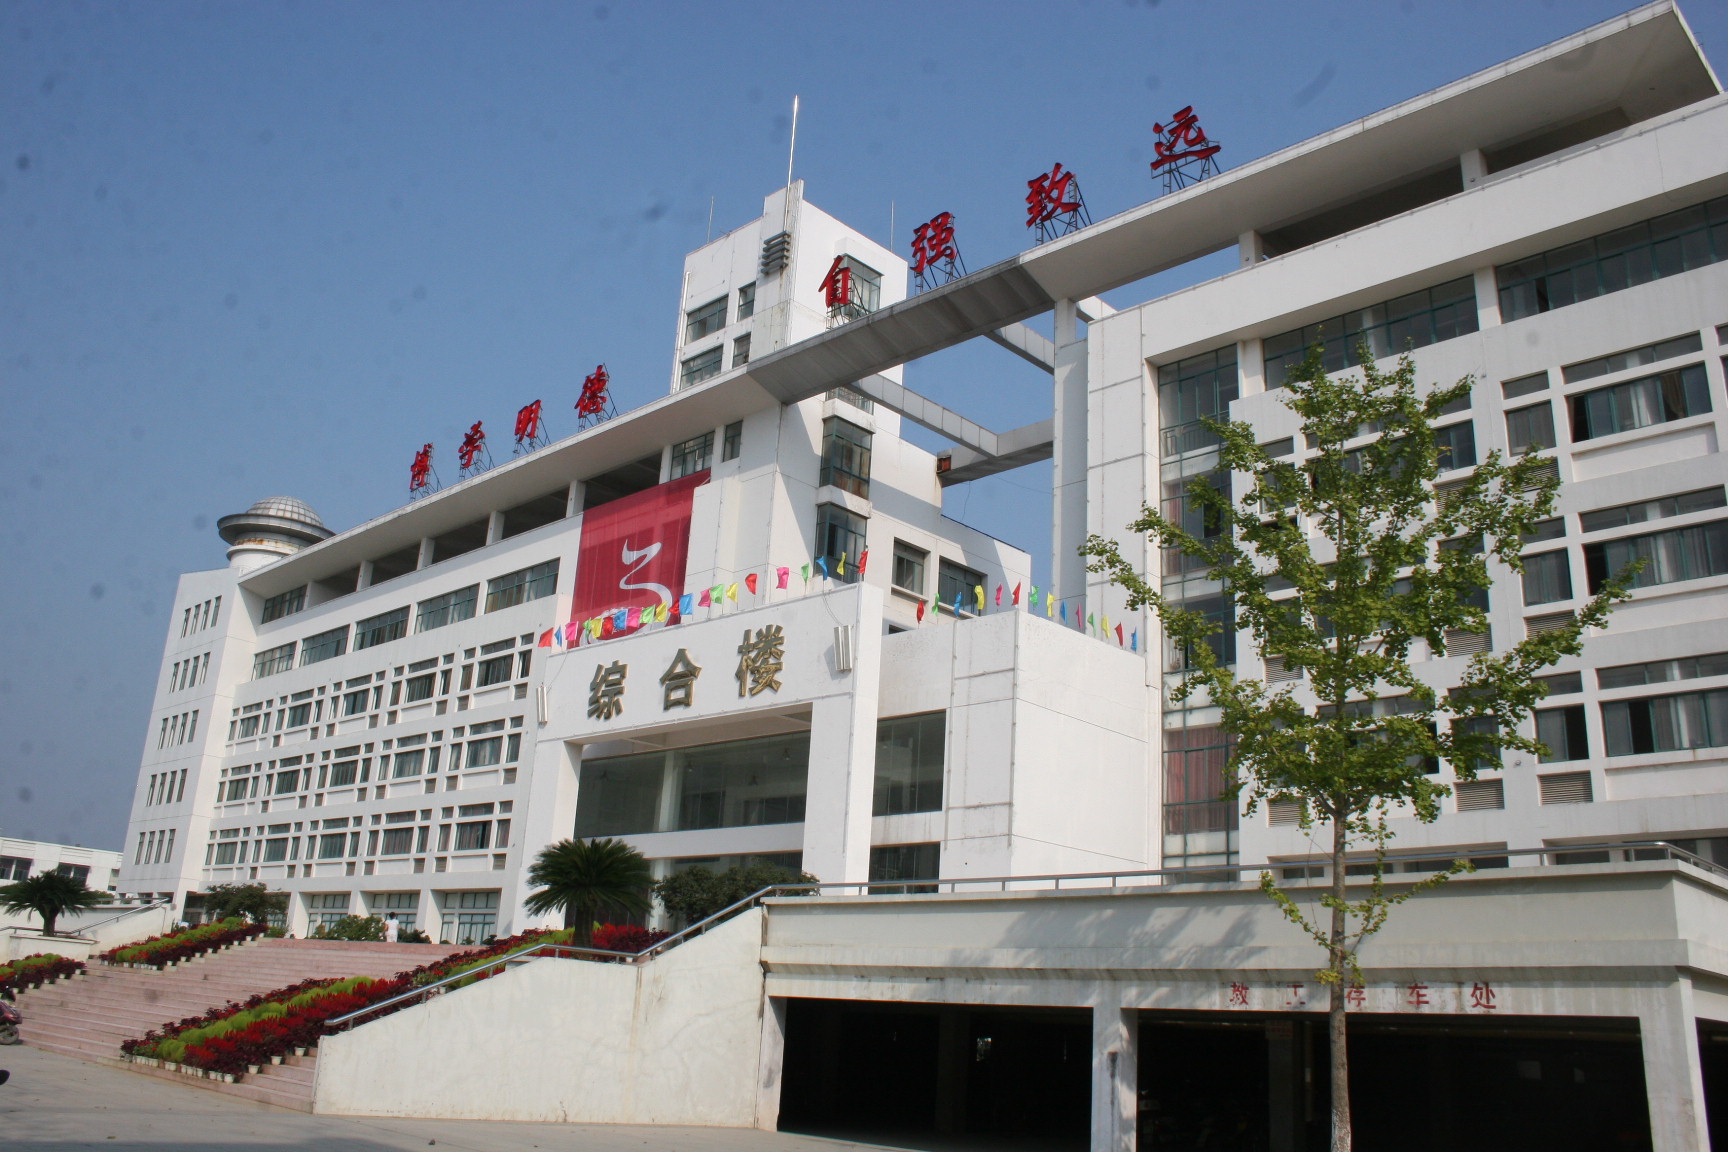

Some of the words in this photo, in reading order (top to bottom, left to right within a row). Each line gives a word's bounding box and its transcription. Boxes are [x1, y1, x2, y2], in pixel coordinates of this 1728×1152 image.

[818, 105, 1221, 307] 自强致远
[587, 624, 785, 719] 综合楼
